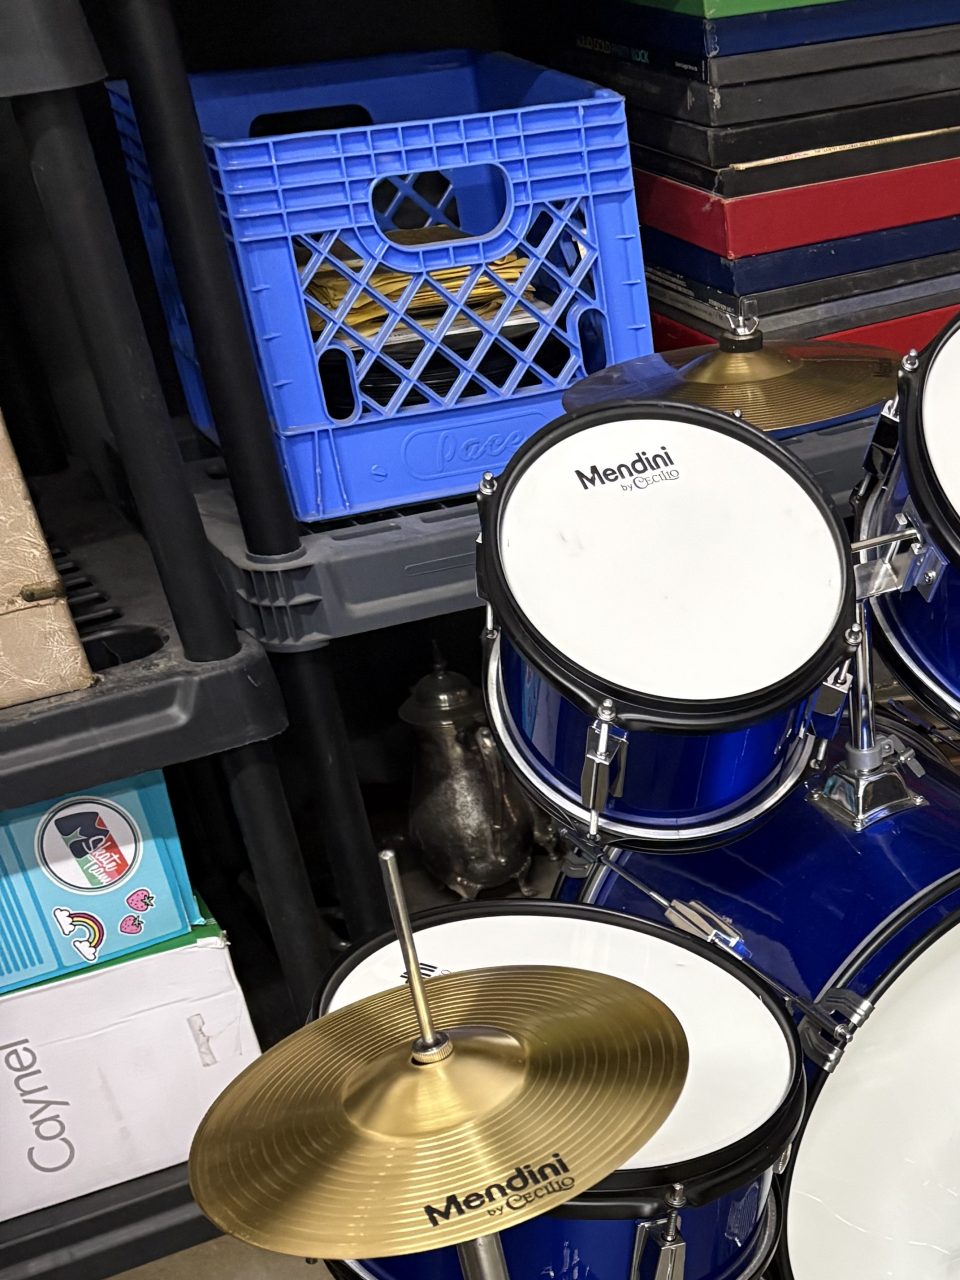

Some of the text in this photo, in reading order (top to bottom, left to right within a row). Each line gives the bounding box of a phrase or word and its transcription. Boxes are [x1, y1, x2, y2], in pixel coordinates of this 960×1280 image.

[574, 445, 675, 490] Mendini
[620, 484, 633, 492] by
[82, 835, 121, 872] Skate
[83, 852, 112, 885] Team
[0, 1038, 76, 1173] Caynel
[423, 1152, 571, 1227] Mendini
[487, 1204, 504, 1217] by
